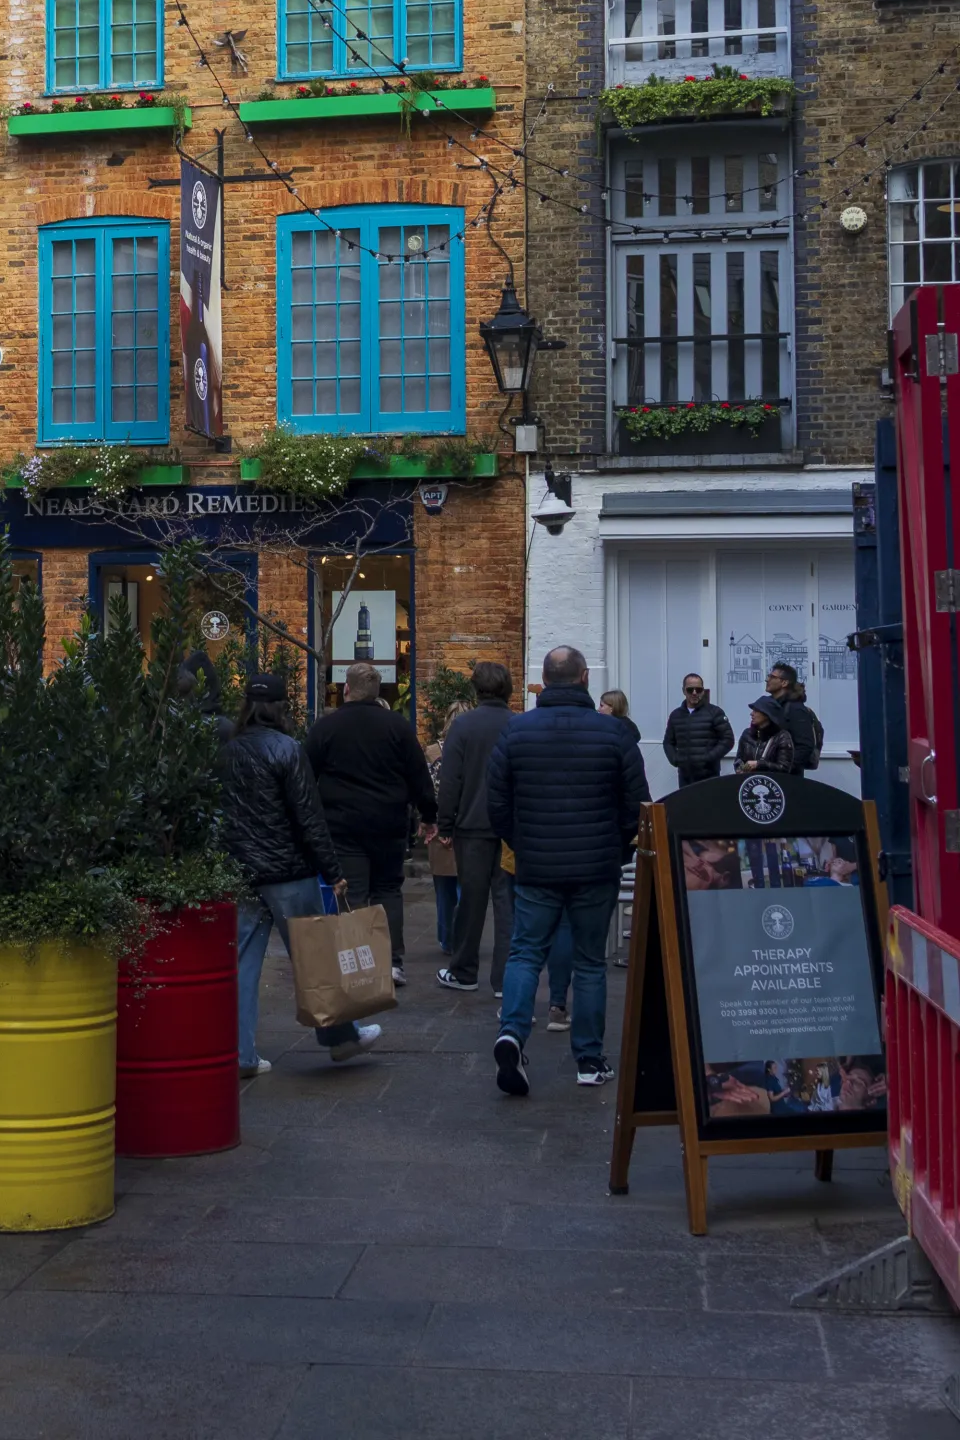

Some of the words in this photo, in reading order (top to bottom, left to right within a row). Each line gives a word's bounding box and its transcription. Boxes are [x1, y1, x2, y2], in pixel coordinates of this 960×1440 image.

[185, 229, 197, 243] Natural
[200, 239, 212, 252] organic
[186, 243, 197, 256] health
[199, 250, 211, 265] beauty
[185, 492, 320, 515] REMEDIES
[768, 604, 804, 612] COVENT
[821, 603, 858, 611] GARDEN
[763, 779, 781, 797] YARD
[744, 804, 781, 820] REMEDIES
[357, 947, 370, 958] UNI
[751, 947, 812, 961] THERAPY
[733, 961, 834, 977] APPOINTMENTS
[750, 977, 822, 991] AVAILABLE
[719, 1000, 743, 1009] Speak
[743, 999, 753, 1007] to
[760, 997, 788, 1006] member
[842, 994, 855, 1002] call
[720, 1009, 737, 1017] 020
[738, 1008, 758, 1016] 3998
[758, 1007, 778, 1016] 9300
[731, 1018, 751, 1027] book
[752, 1018, 768, 1026] your
[770, 1016, 816, 1026] appointment
[817, 1014, 839, 1022] online
[749, 1024, 834, 1036] nealsyardremedies.com
